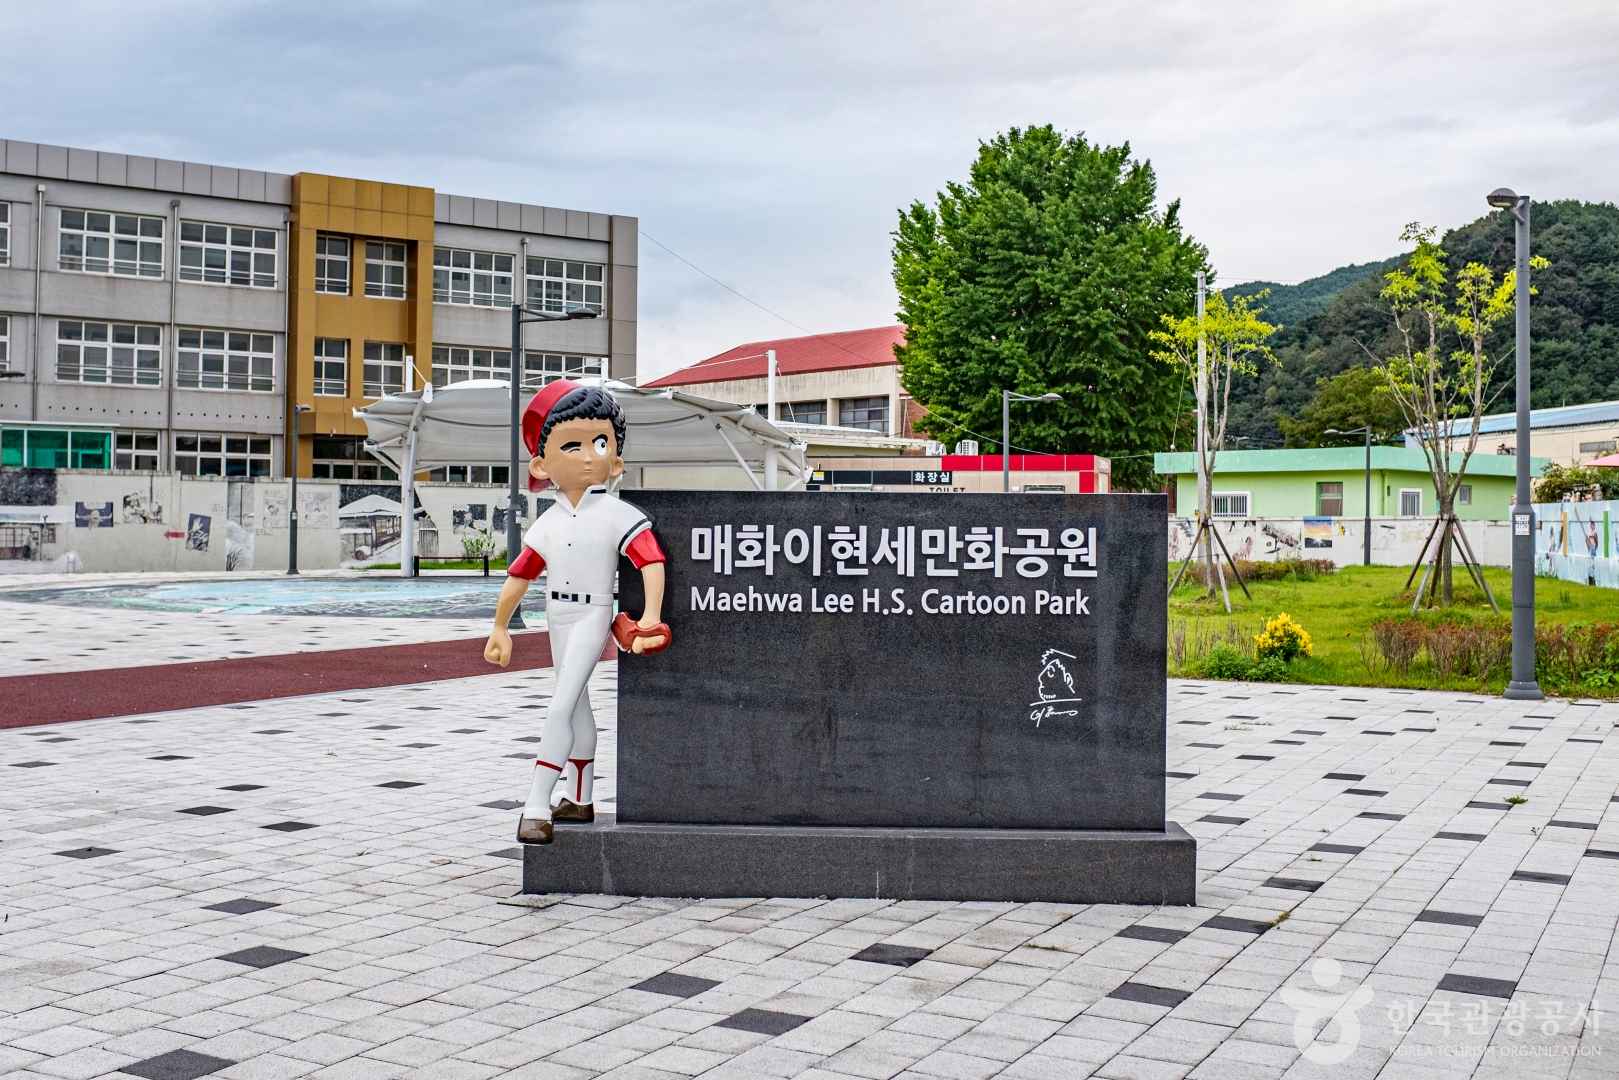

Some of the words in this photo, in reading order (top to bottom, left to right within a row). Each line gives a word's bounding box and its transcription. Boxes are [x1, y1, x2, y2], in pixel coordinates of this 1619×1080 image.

[914, 471, 950, 483] 화장실
[690, 524, 1098, 578] 매화이현세만화공원
[690, 585, 803, 612] Maehwa
[811, 588, 854, 613] Lee
[862, 588, 913, 616] H.S.
[921, 588, 1026, 615] Cartoon
[1035, 589, 1090, 616] Park
